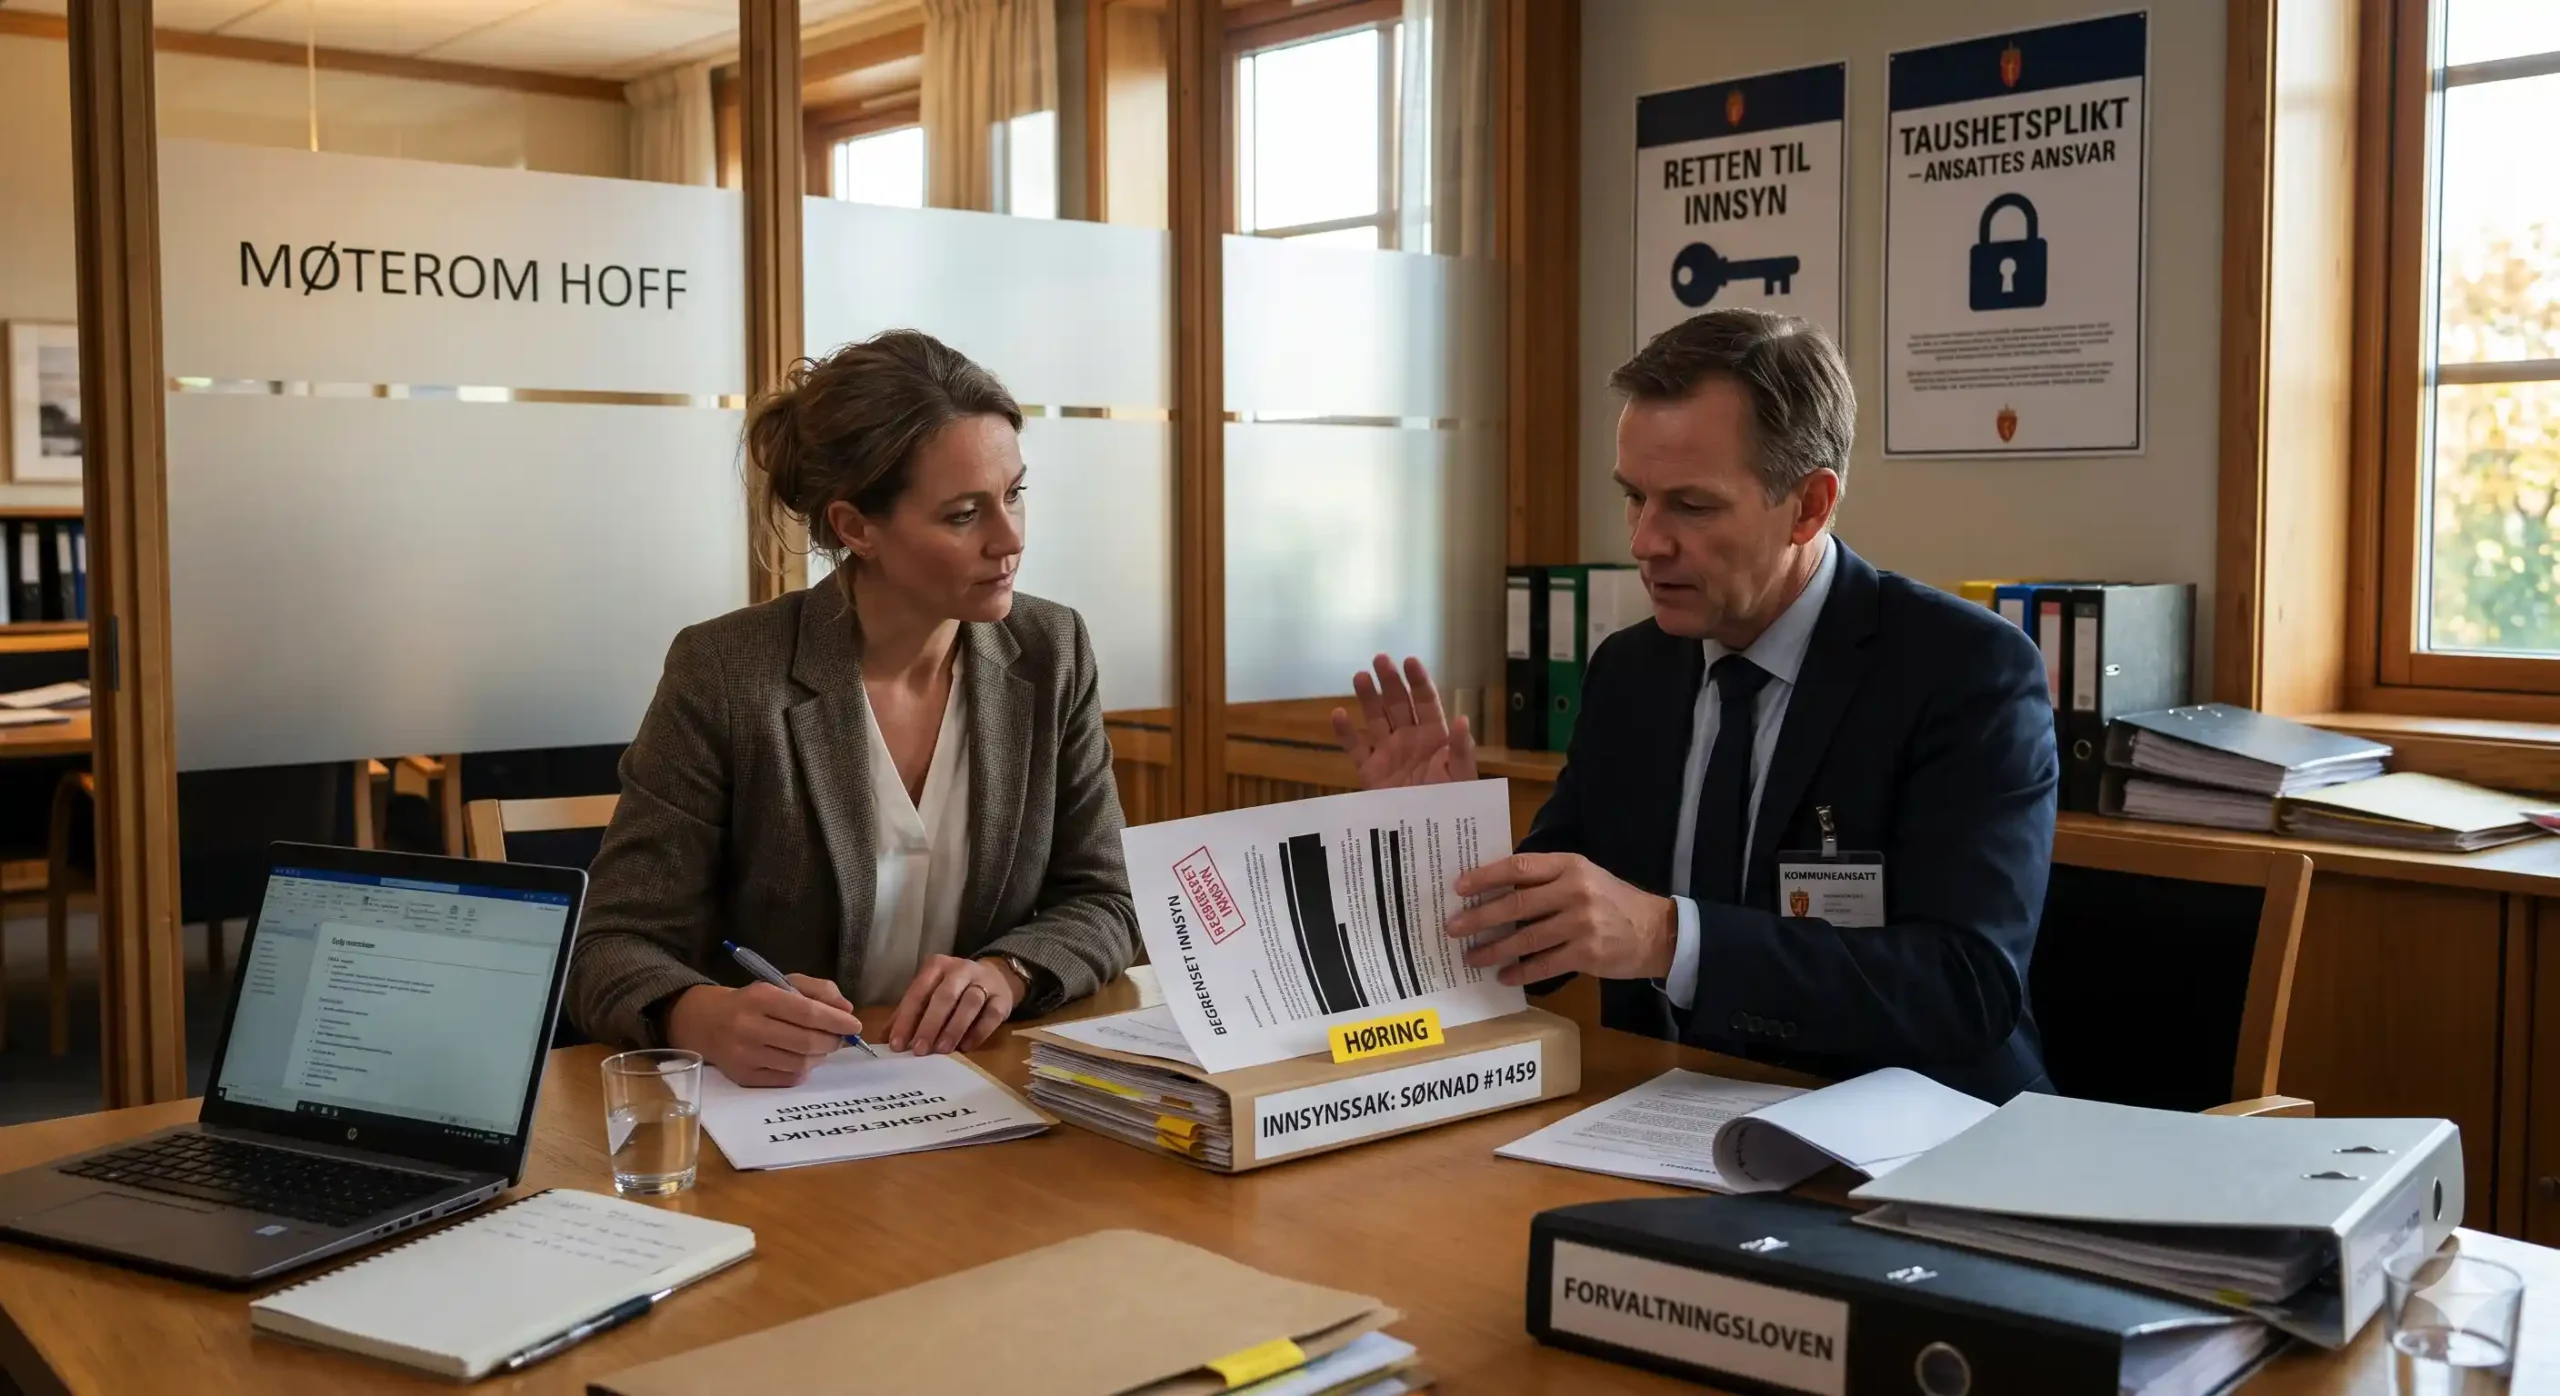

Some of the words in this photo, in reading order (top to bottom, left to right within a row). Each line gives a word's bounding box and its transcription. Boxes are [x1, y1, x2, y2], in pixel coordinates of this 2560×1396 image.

[1900, 97, 2130, 156] TAUSHETSPLIKT
[1663, 147, 1762, 190] RETTEN
[1769, 141, 1811, 174] TIL
[2030, 140, 2116, 172] ANSVAR
[1684, 184, 1787, 225] INNSYN
[239, 240, 540, 302] MØTEROM
[561, 261, 688, 310] HOFF
[1784, 871, 1877, 881] KOMMUNEANSATT
[1168, 895, 1193, 951] INNSYN
[1183, 955, 1228, 1036] BEGRENSET
[1343, 1018, 1428, 1053] HØRING
[768, 1107, 977, 1143] TAUSHETSPLIKT
[1262, 1090, 1396, 1138] INNSYNSSAK:
[1400, 1073, 1479, 1108] SØKNAD
[1484, 1060, 1537, 1090] #1459
[1564, 1277, 1834, 1361] FORVALTNINGSLOVEN
